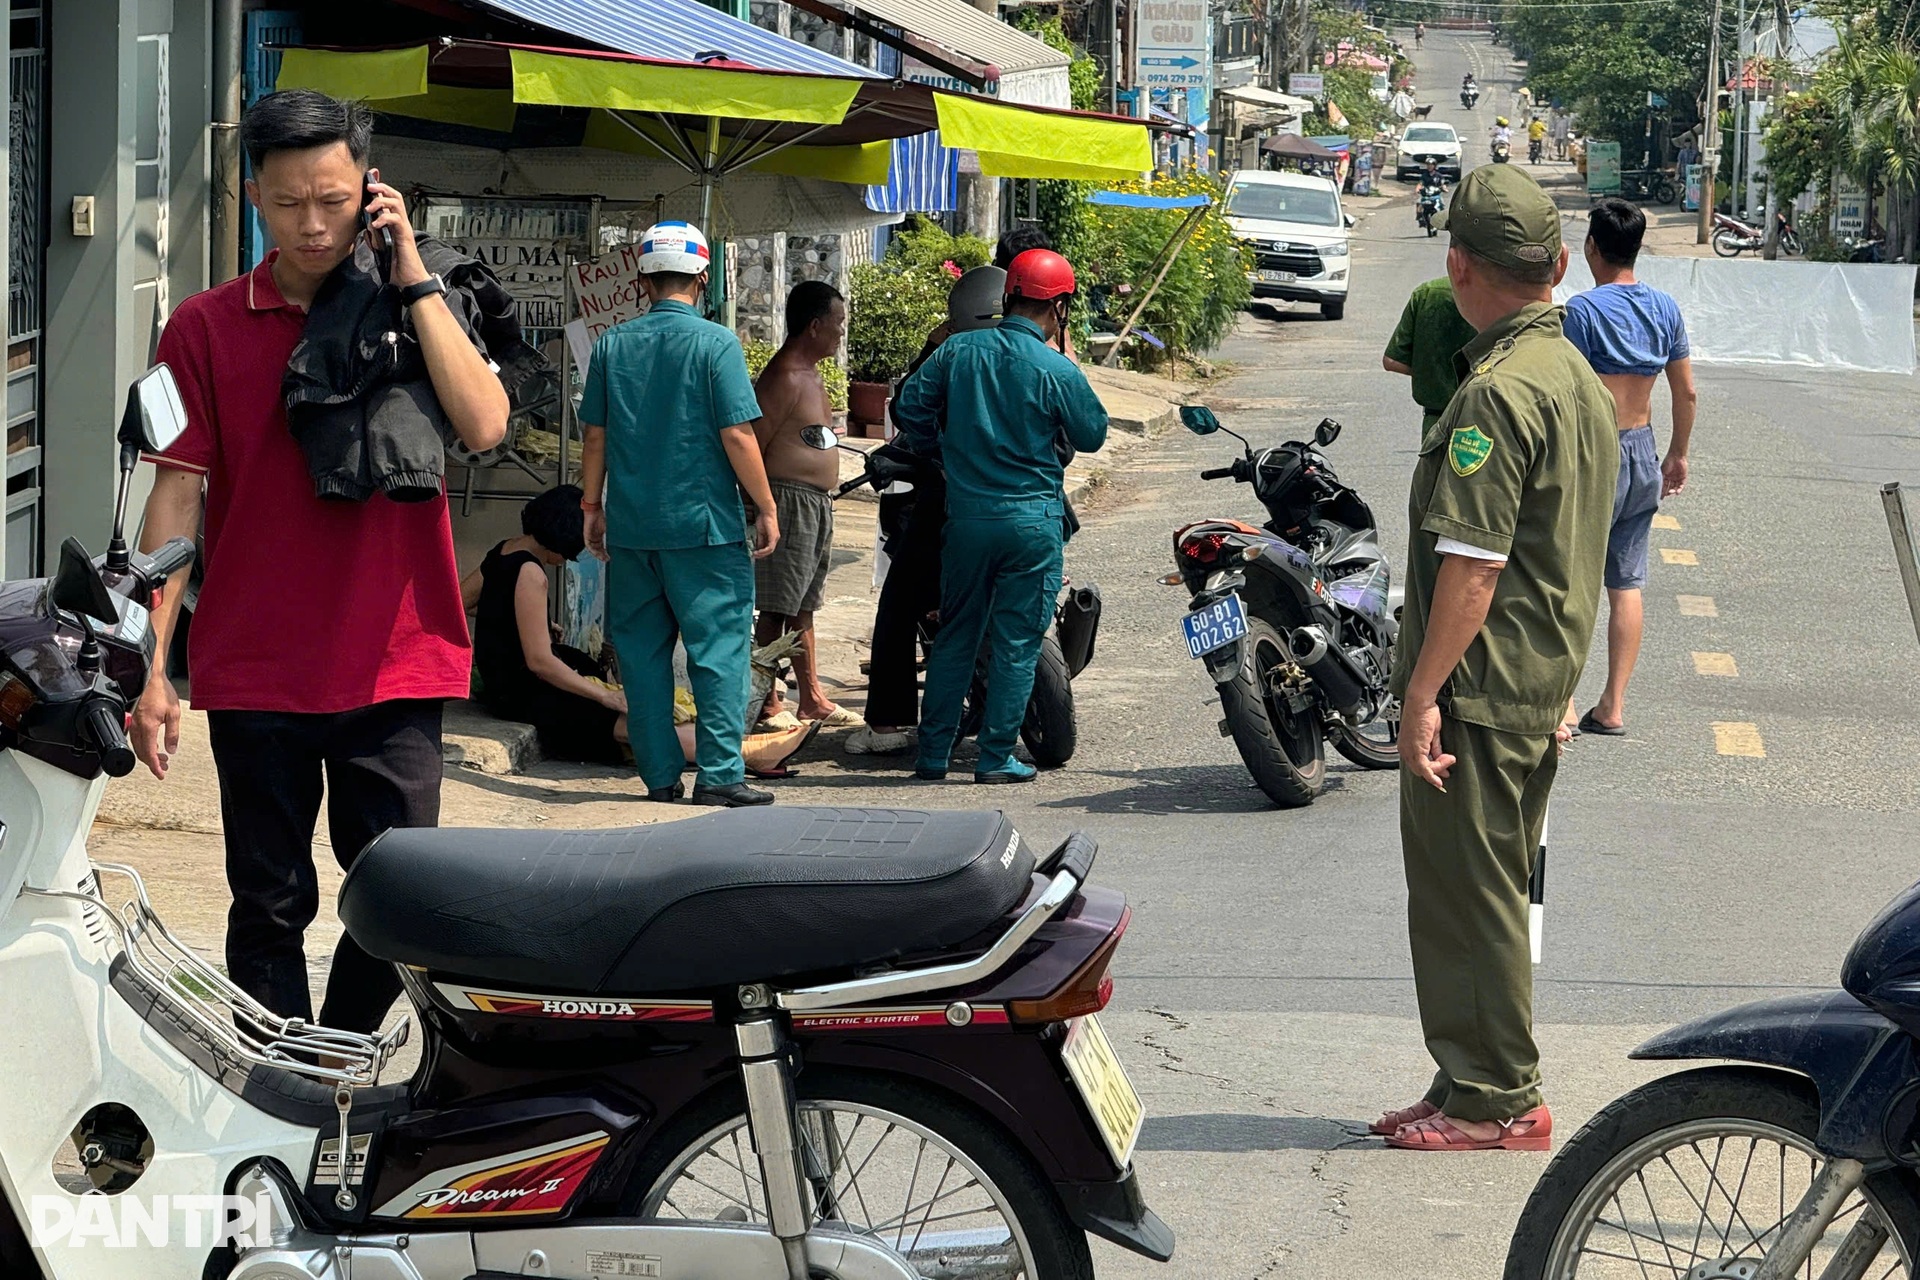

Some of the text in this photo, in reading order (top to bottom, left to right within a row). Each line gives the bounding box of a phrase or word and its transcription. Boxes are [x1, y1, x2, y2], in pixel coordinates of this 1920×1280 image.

[1147, 74, 1204, 83] 0974 279 379
[518, 240, 562, 266] MÁ
[577, 261, 620, 287] RAU
[1190, 600, 1232, 633] 60-B1
[1190, 616, 1244, 654] 002.62
[542, 1000, 636, 1016] HONDA
[803, 1015, 920, 1026] ELECTRIC STARTER
[416, 1177, 565, 1208] Dream II
